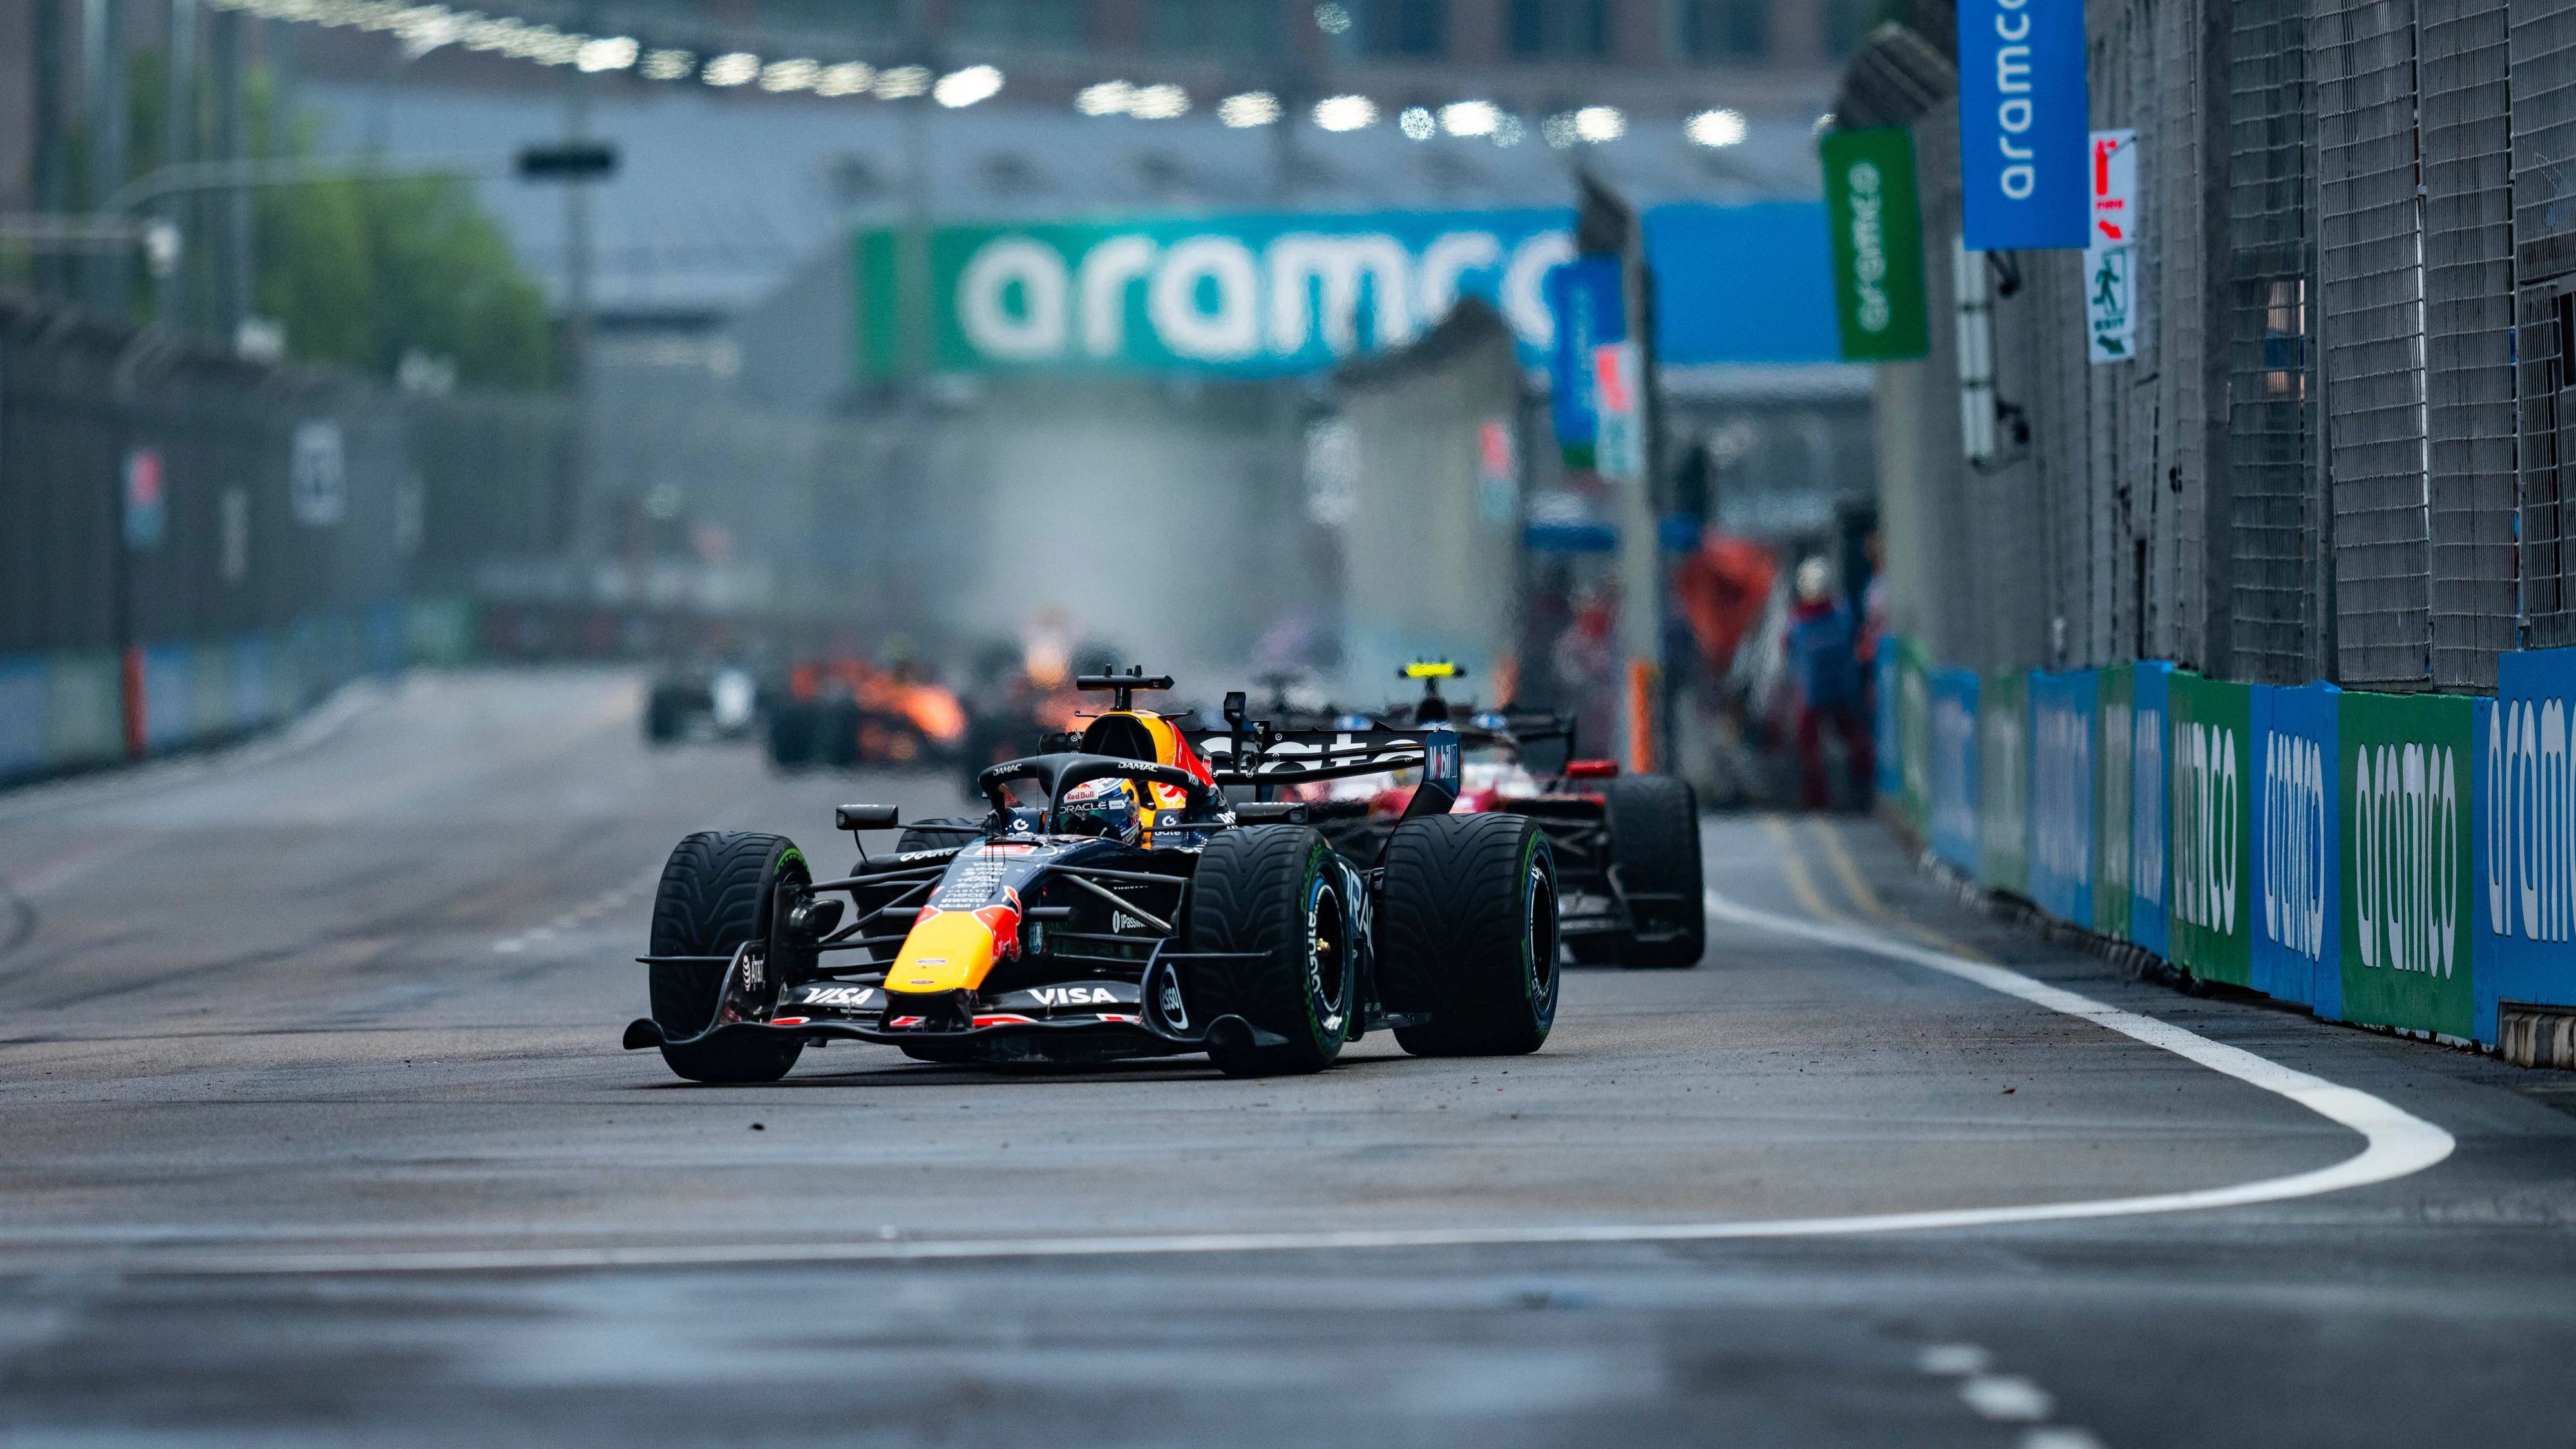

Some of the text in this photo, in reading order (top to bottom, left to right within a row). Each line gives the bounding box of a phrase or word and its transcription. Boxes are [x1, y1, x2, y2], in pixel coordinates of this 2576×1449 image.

[1996, 0, 2036, 200] aramc
[1118, 762, 1158, 772] DAMAC
[1429, 744, 1450, 781] Mobil
[2488, 697, 2576, 943] aram
[2264, 730, 2324, 962] aramco
[2356, 742, 2456, 980] aramco
[1121, 914, 1148, 929] 1Passw
[803, 988, 875, 1005] VISA
[1027, 987, 1119, 1005] VISA
